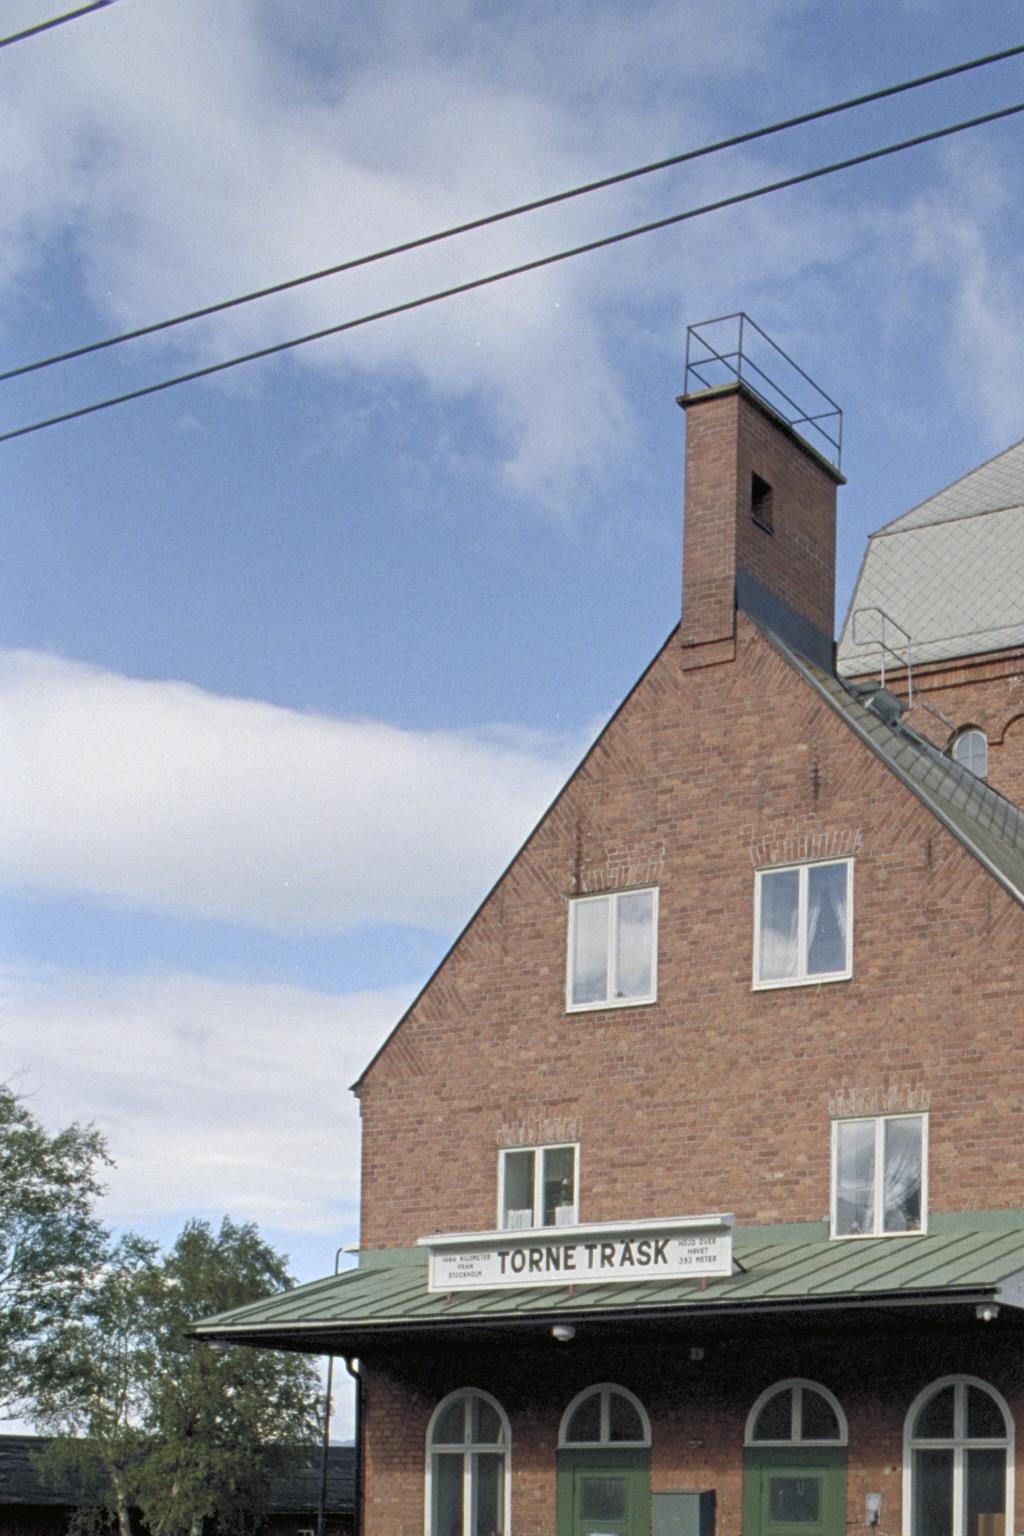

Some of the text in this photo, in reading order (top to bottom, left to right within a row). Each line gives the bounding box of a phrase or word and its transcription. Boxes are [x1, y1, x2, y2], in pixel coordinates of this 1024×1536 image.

[687, 1246, 708, 1255] HAVET
[497, 1238, 671, 1275] TORNE TRÄSK
[695, 1255, 717, 1263] METER
[448, 1270, 482, 1279] STOCKHOLM
